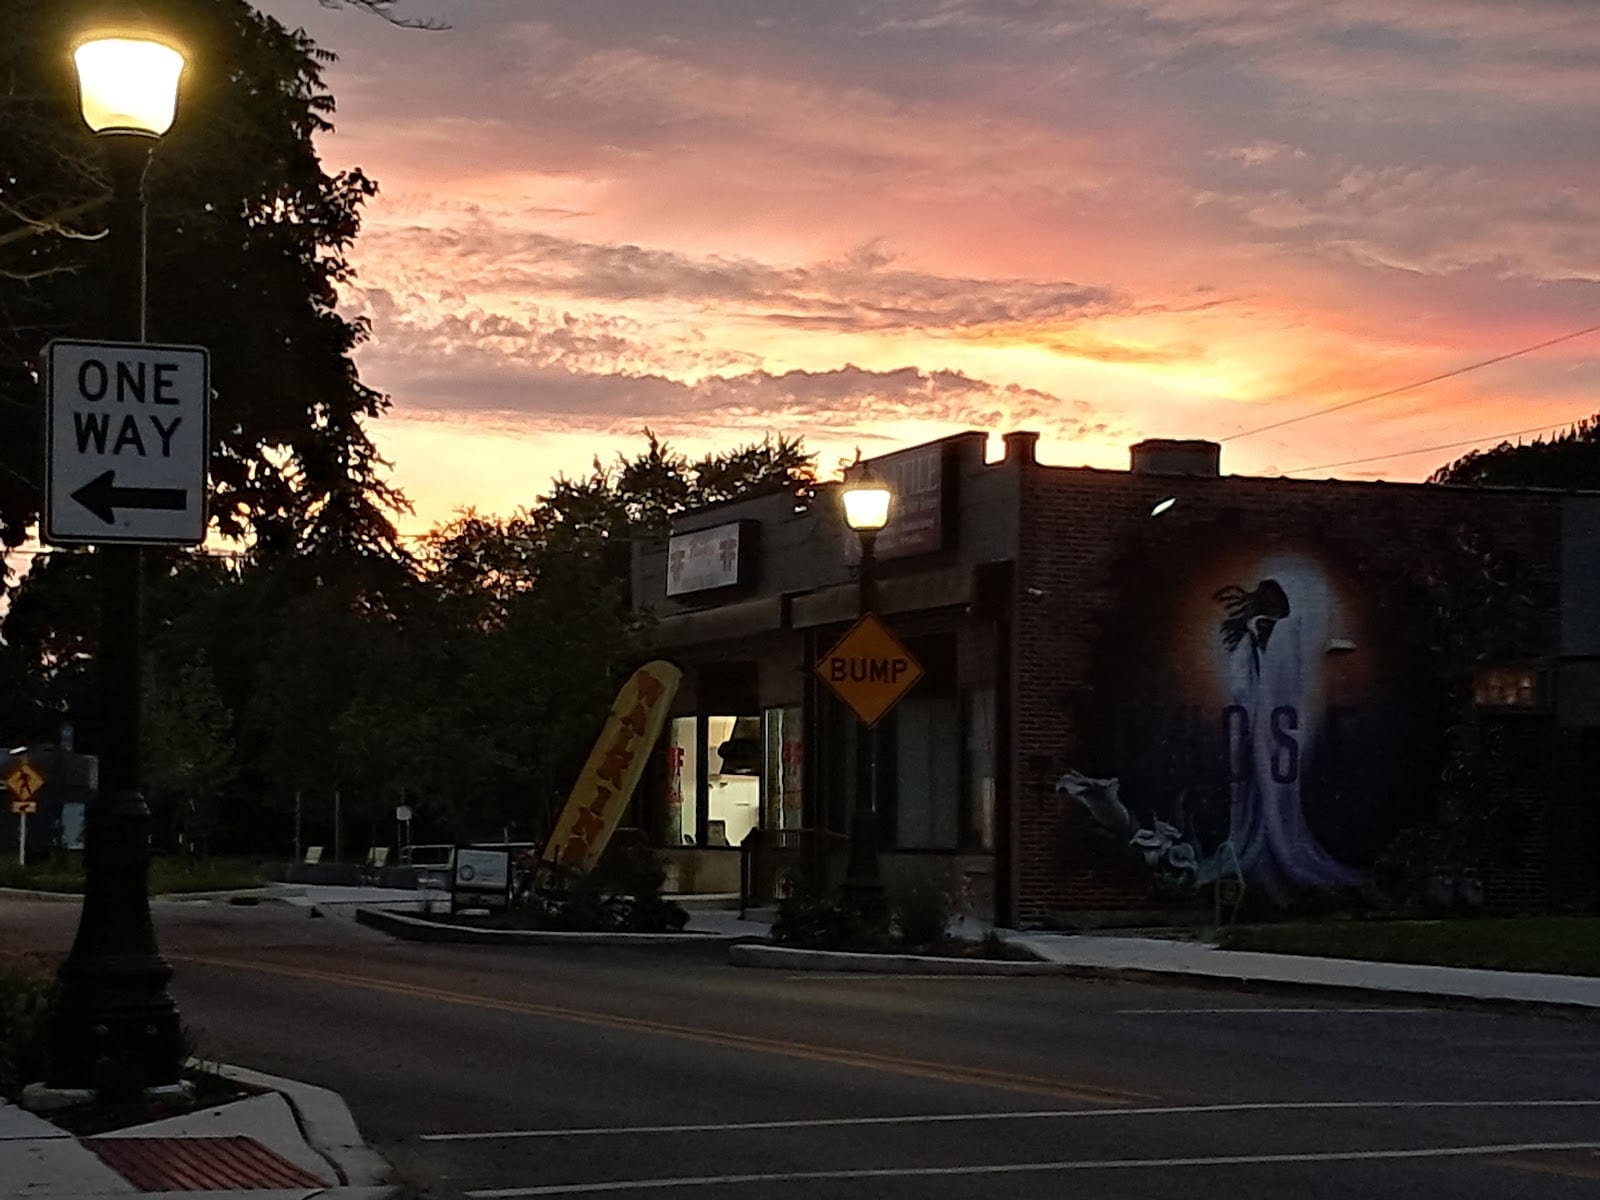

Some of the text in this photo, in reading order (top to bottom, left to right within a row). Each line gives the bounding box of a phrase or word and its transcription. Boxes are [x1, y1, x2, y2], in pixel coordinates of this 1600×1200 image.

[78, 359, 180, 404] ONE
[74, 412, 182, 458] WAY
[831, 657, 908, 684] BUMP
